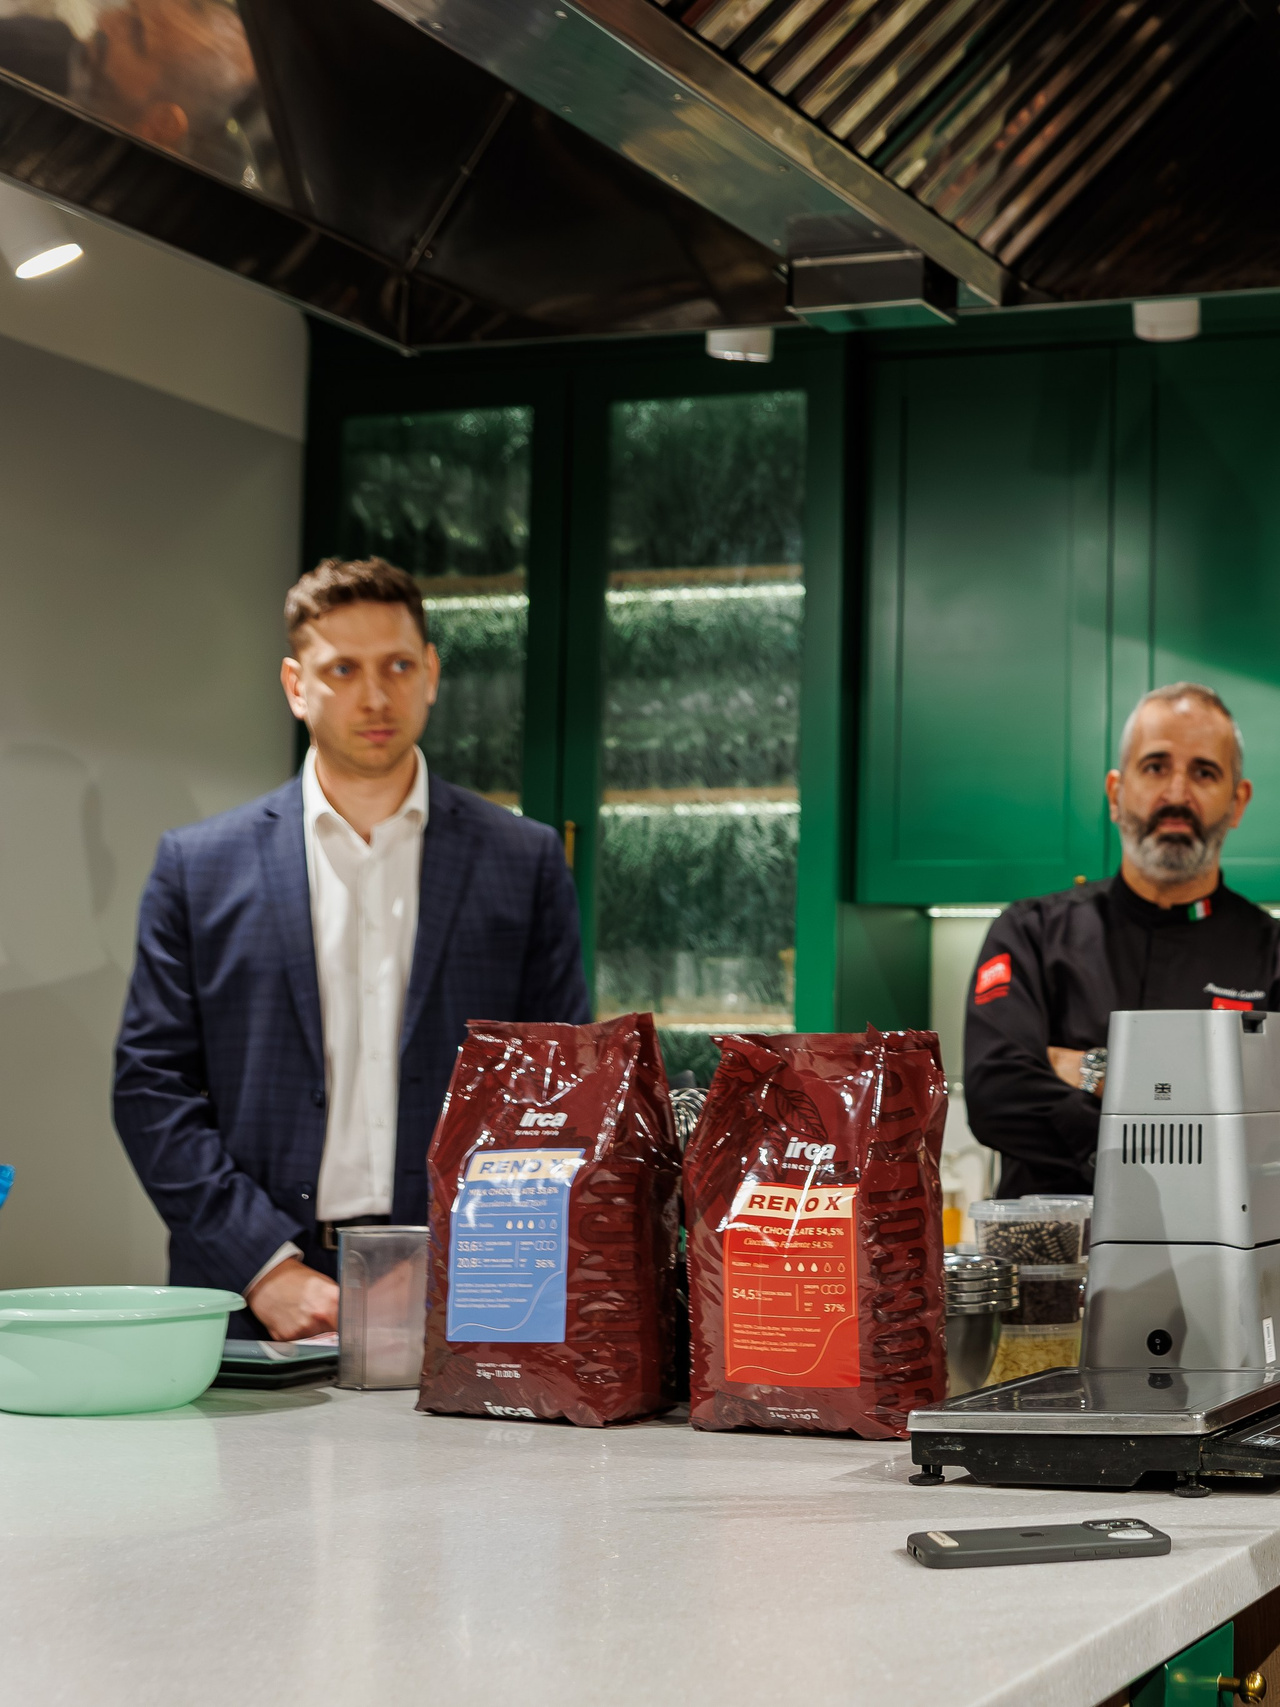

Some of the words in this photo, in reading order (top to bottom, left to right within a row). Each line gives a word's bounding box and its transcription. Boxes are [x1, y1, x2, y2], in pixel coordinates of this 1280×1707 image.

[519, 1108, 568, 1127] irca
[785, 1137, 837, 1161] irca
[479, 1155, 543, 1174] RENO
[782, 1163, 810, 1172] SINCE
[748, 1194, 820, 1213] RENO
[824, 1196, 843, 1212] X
[762, 1225, 815, 1236] CHOCLATE
[816, 1226, 845, 1237] 54,5%
[823, 1303, 846, 1313] 37%
[483, 1401, 538, 1418] irca
